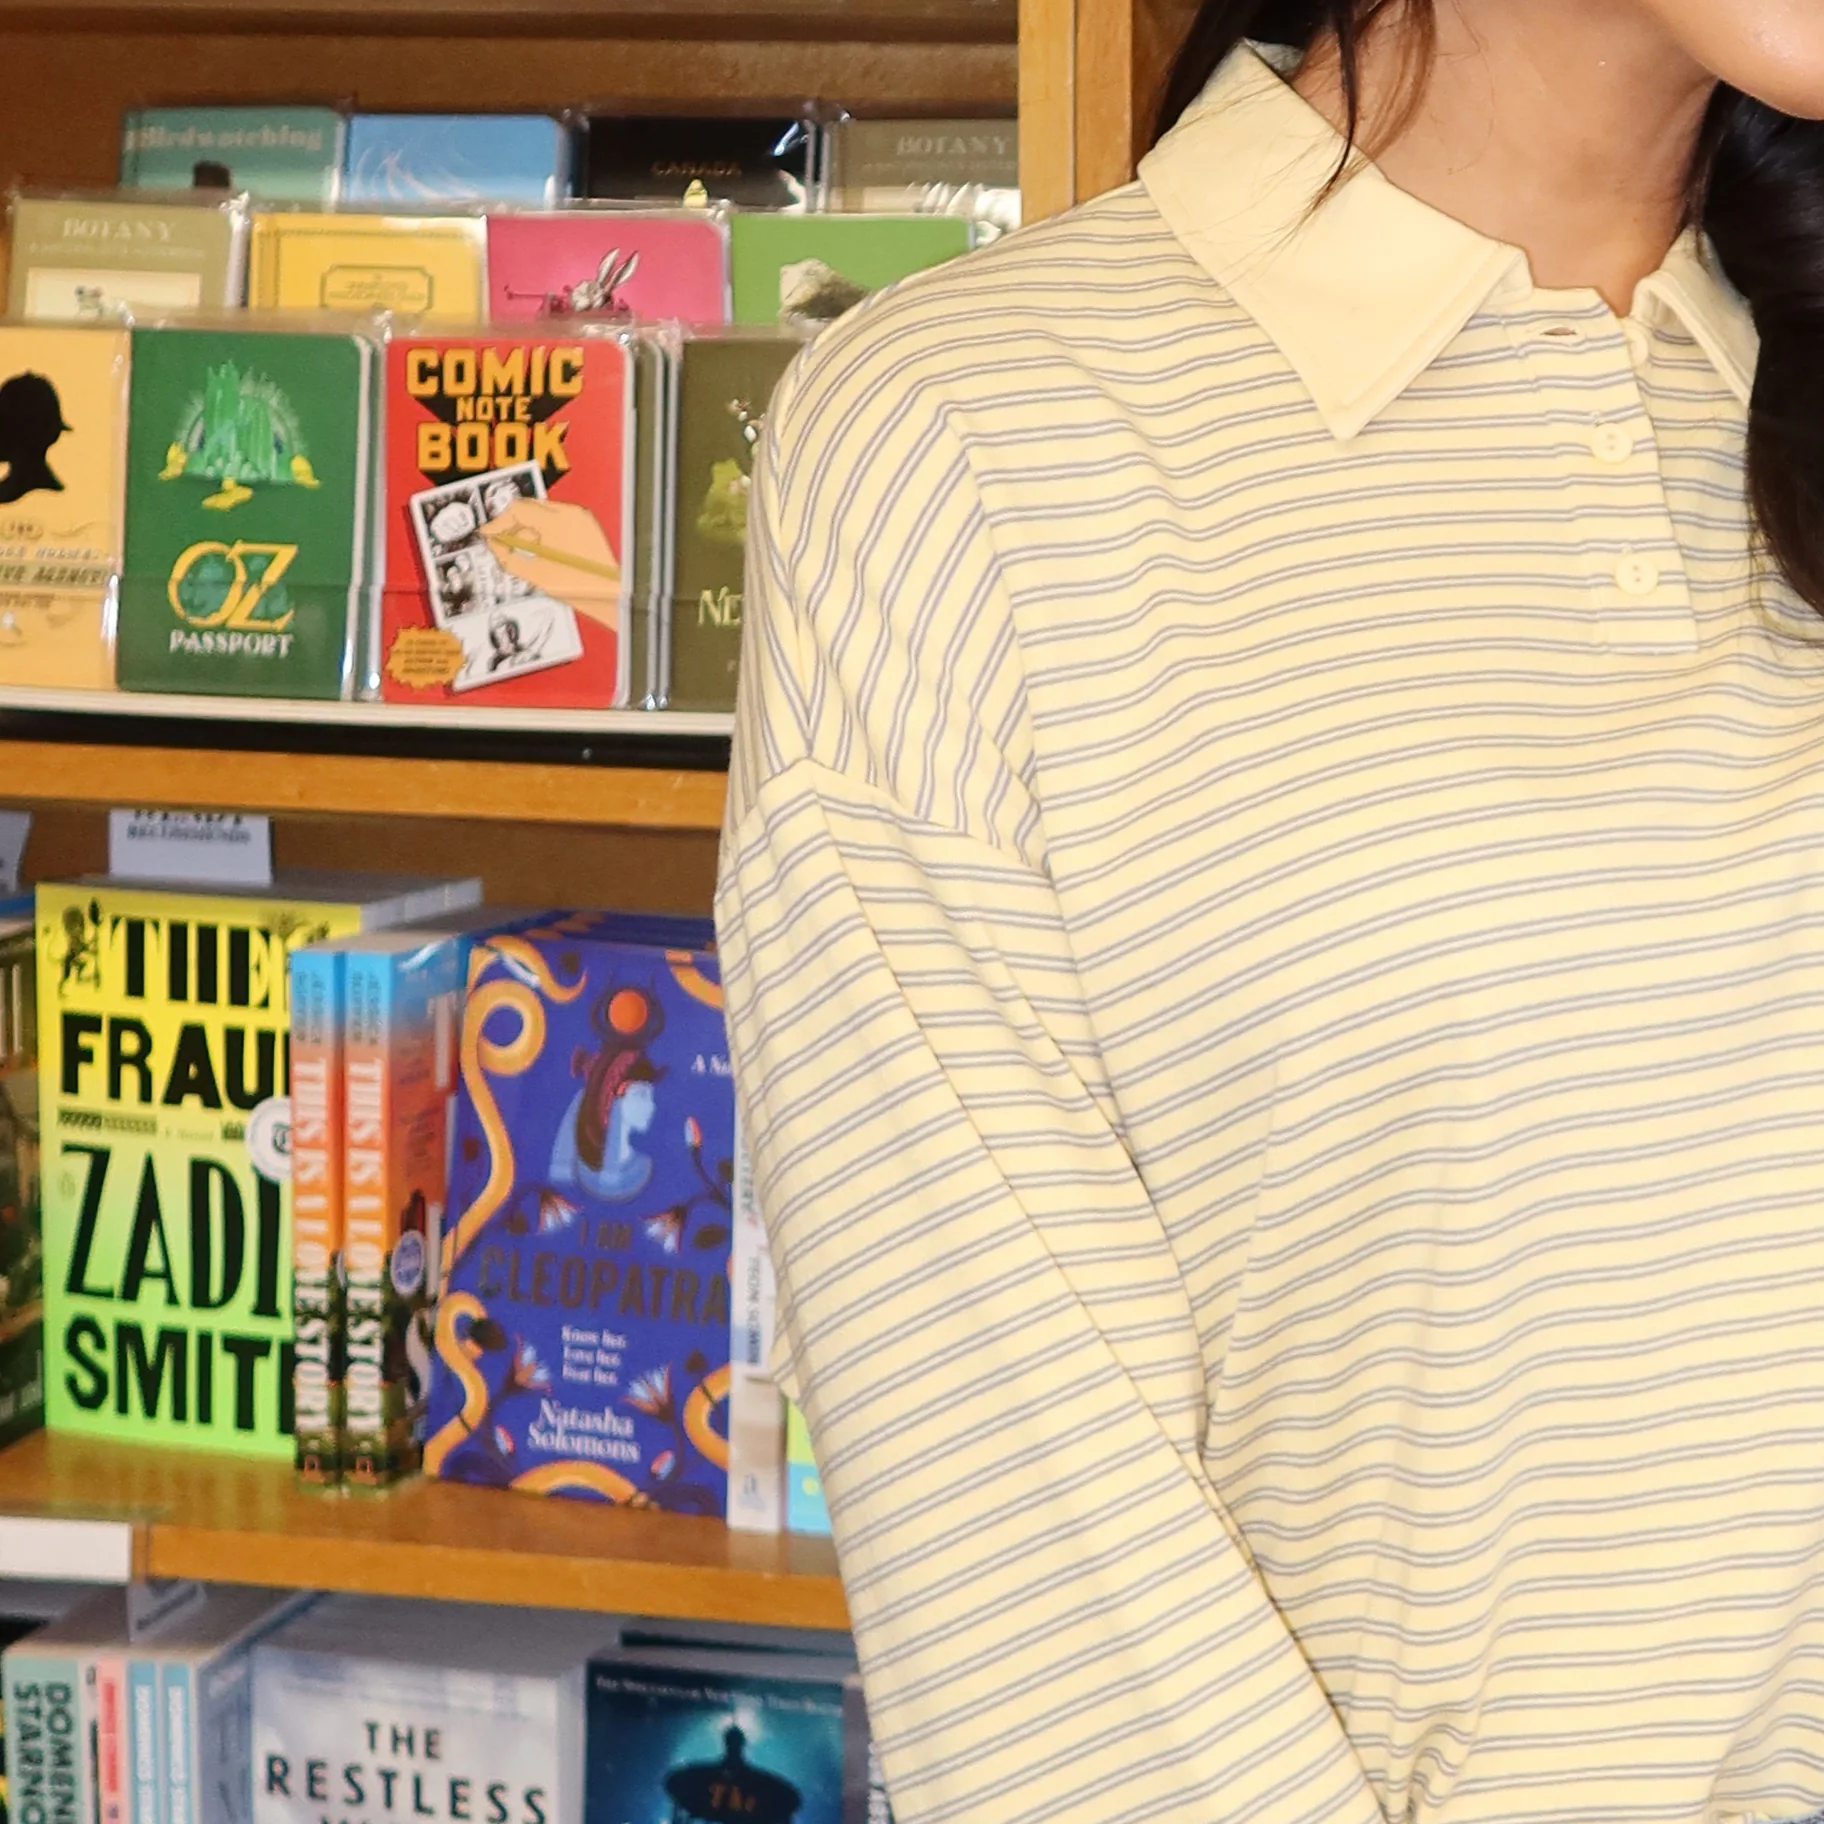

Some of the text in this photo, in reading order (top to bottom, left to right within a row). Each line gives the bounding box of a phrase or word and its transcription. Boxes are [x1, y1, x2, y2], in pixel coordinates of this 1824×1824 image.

[405, 346, 585, 397] COMIC
[456, 395, 532, 423] NOTE
[417, 422, 571, 472] BOOK
[168, 629, 294, 658] PASSPORT
[111, 914, 271, 1011] THE
[59, 1015, 290, 1112] FRAU
[60, 1142, 294, 1320] ZADI
[478, 1242, 729, 1327] CLEOPATRA
[526, 1423, 640, 1463] Solomons
[540, 1398, 635, 1440] Natasha
[365, 1722, 444, 1760] THE
